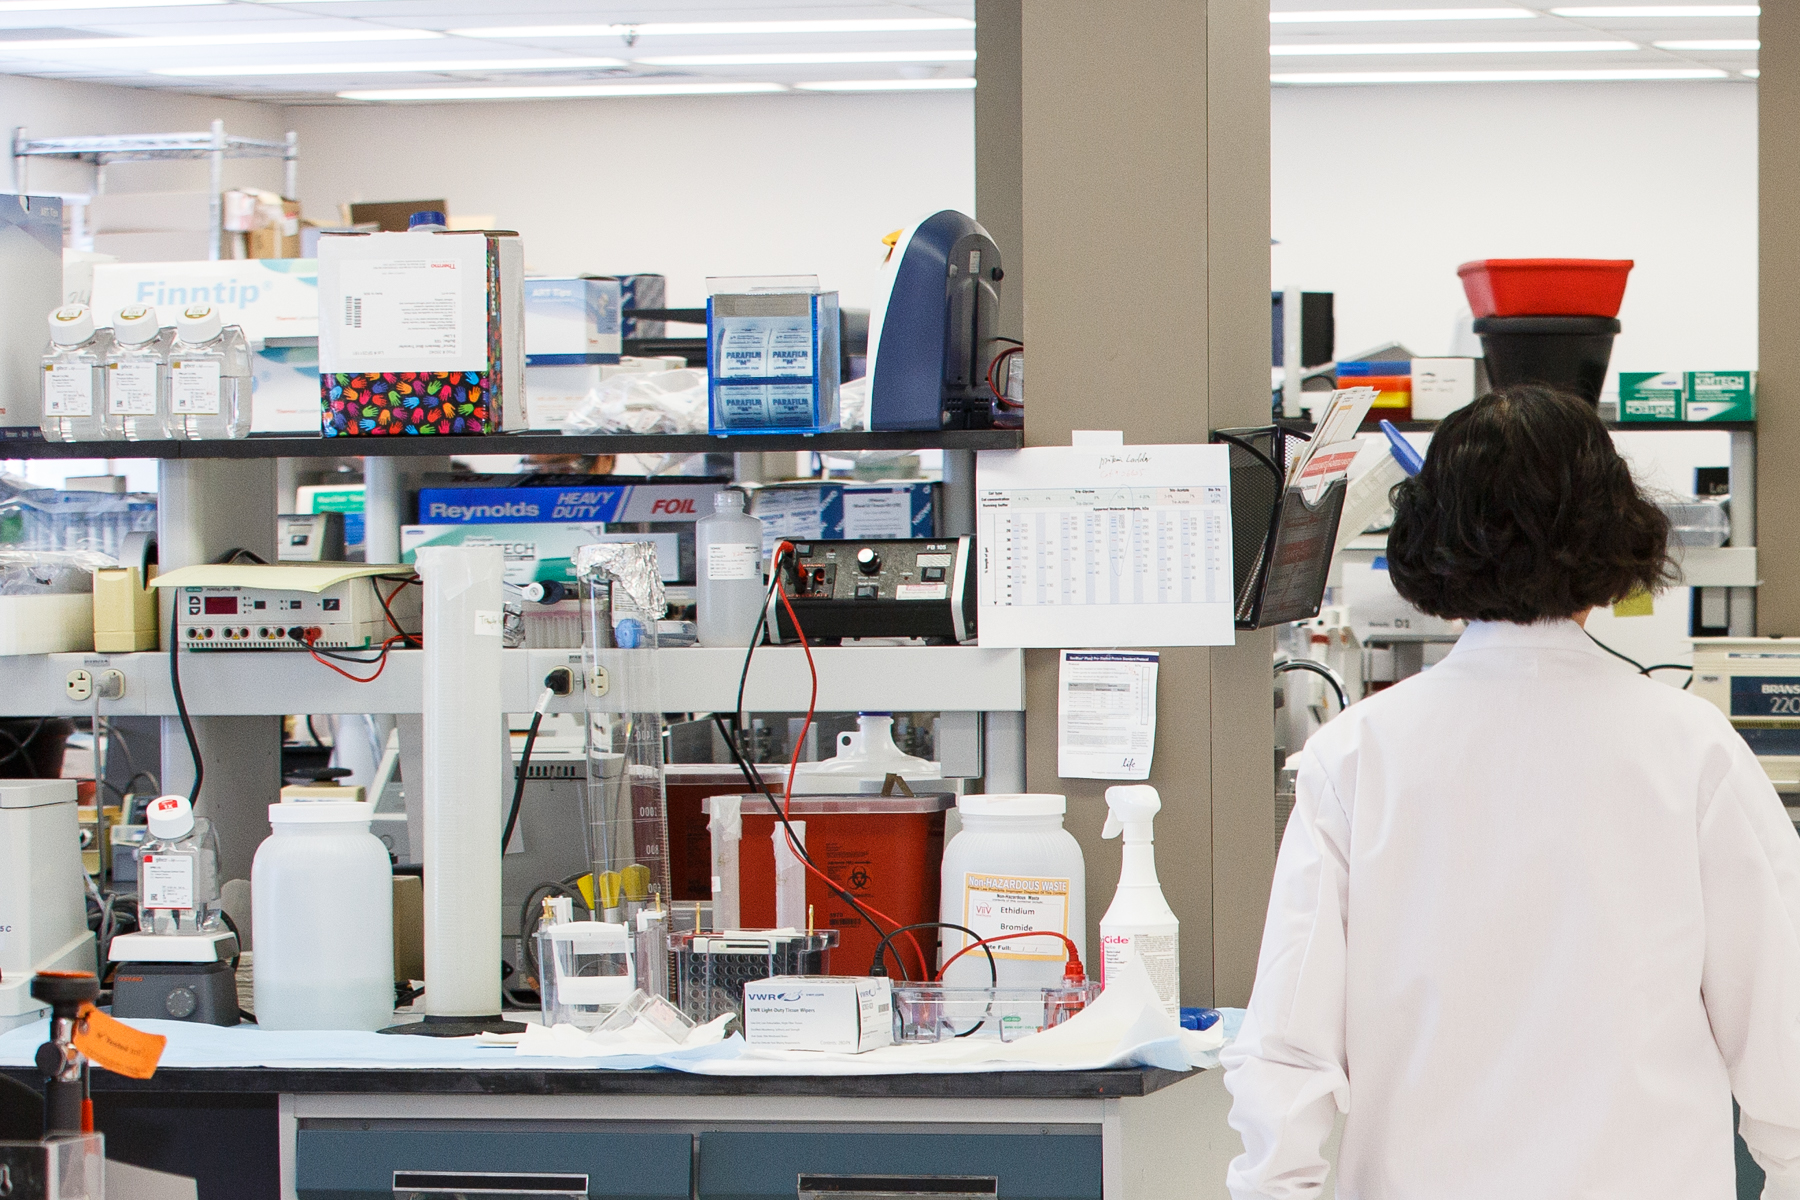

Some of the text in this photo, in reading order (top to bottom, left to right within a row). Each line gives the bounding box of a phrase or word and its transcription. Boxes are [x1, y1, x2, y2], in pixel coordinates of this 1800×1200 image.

[136, 280, 260, 309] Finntip
[726, 351, 762, 359] PARAFILM
[1695, 376, 1744, 387] KIMTECH
[772, 398, 808, 406] PARAFILM
[1626, 405, 1675, 414] KIMTECH
[557, 491, 615, 505] HEAVY
[429, 502, 540, 521] Reynolds
[552, 505, 600, 518] DUTY
[652, 499, 697, 514] FOIL
[969, 876, 1067, 891] Non-HAZARDOUS WASTE
[976, 905, 992, 914] ViiV
[1000, 906, 1035, 915] Ethidium
[1000, 922, 1034, 931] Bromide
